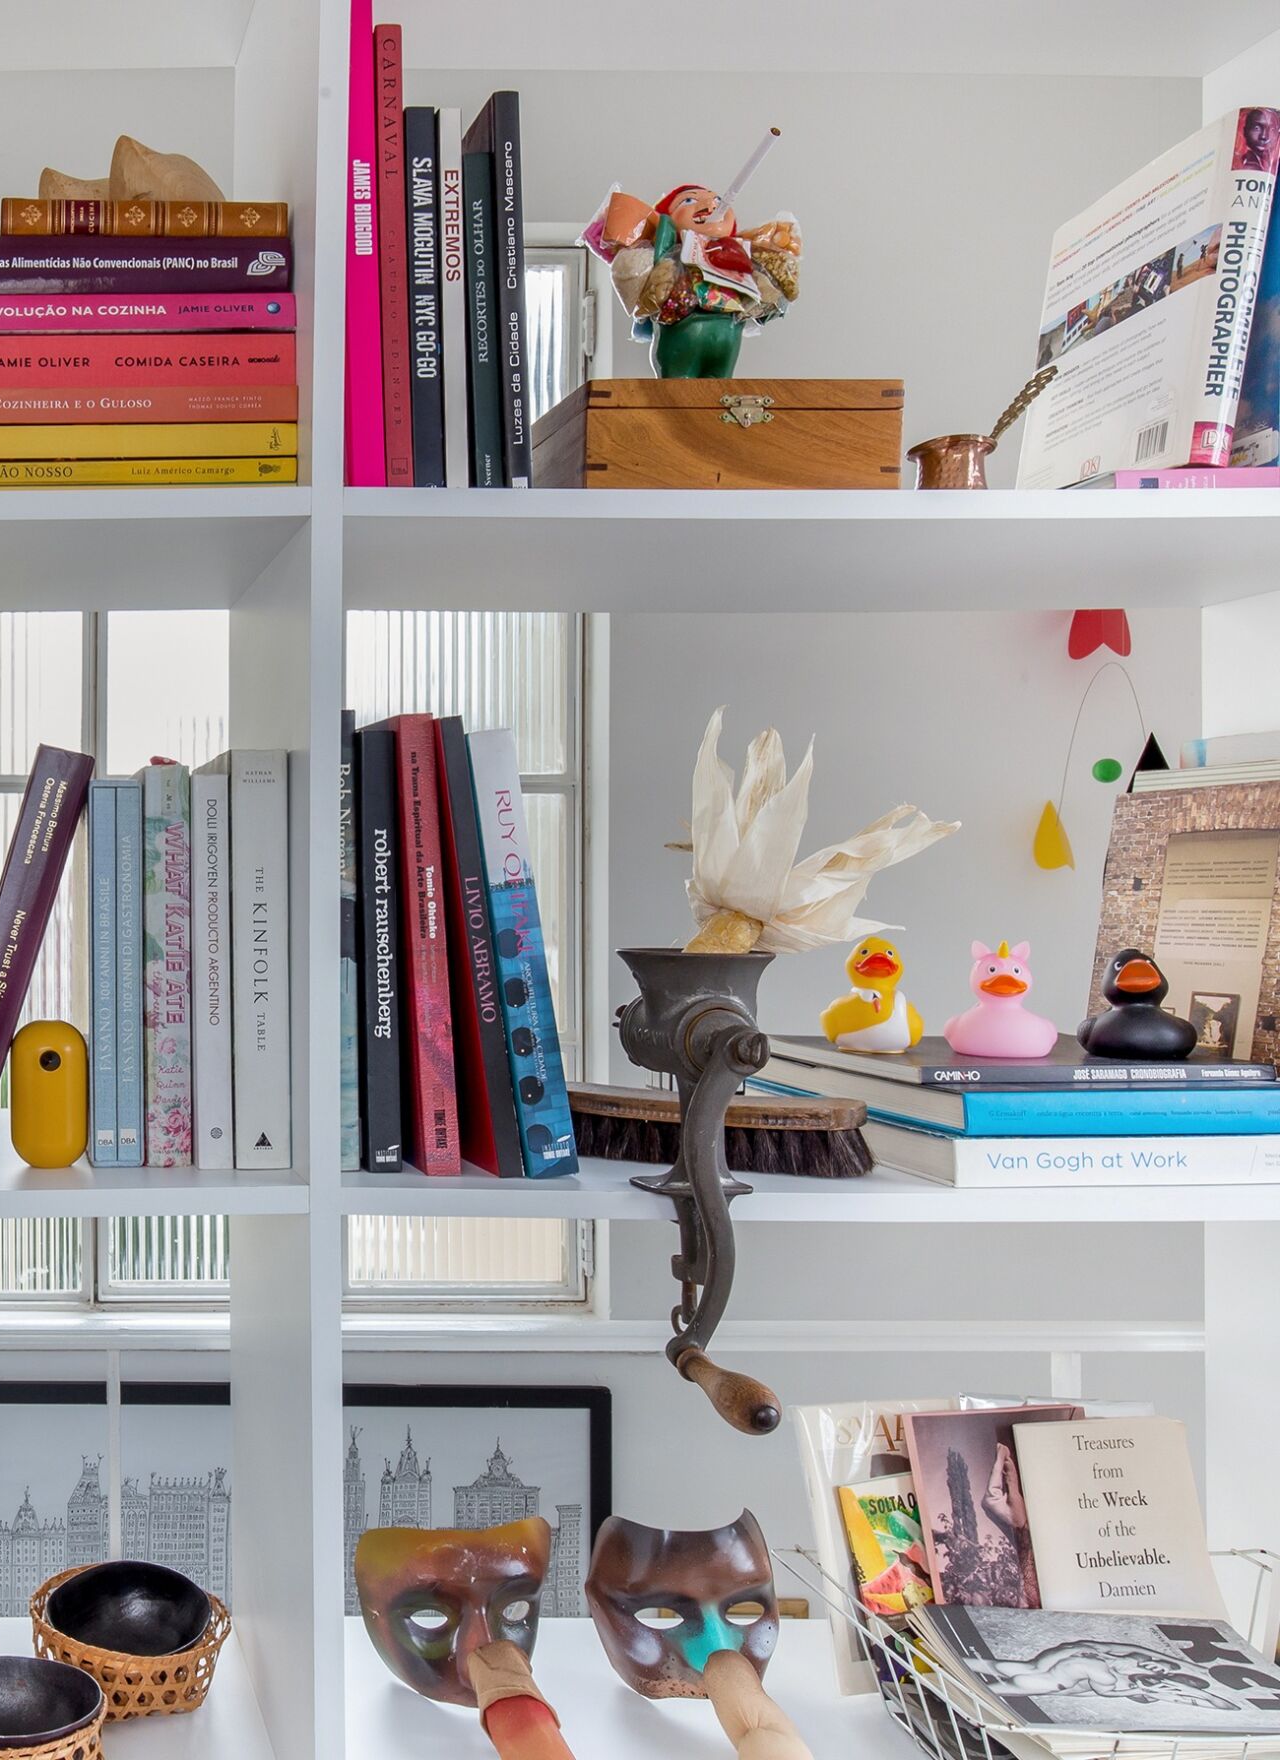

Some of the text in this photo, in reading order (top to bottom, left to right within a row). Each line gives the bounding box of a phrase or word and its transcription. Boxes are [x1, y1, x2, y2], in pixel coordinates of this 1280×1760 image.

[352, 159, 371, 200] JAMES
[382, 38, 399, 319] CARNAVAL CLAUDIO
[444, 170, 461, 282] EXTREMOS
[11, 257, 70, 268] Alimentícias
[72, 257, 92, 268] Não
[93, 257, 161, 269] Convencionais
[162, 257, 195, 271] (PANC)
[196, 260, 209, 268] no
[211, 257, 238, 268] Brasil
[412, 156, 437, 378] SLAVA MOGUTIN NYC GO-GO
[472, 199, 490, 363] RECORTES OLHAR
[72, 306, 93, 316] NA
[97, 305, 167, 316] COZINHA
[178, 305, 210, 315] JAMIE
[214, 304, 254, 314] OLIVER
[504, 141, 524, 445] Luzes da Cidade Cristiano Mascaro
[1204, 221, 1248, 397] PHOTOGRAPHER
[38, 357, 90, 368] OLIVER
[114, 356, 173, 367] COMIDA
[179, 356, 240, 366] CASEIRA
[24, 466, 73, 478] NOSSO
[131, 467, 150, 476] Luiz
[154, 465, 192, 475] Américo
[195, 466, 235, 476] Camargo
[495, 789, 519, 846] RUY
[24, 811, 46, 864] Francescana
[411, 752, 426, 939] na Trama da Arte Brasileira
[99, 877, 110, 929] BRASILE
[121, 835, 133, 938] GASTRONOMIA
[10, 910, 27, 941] Never
[165, 821, 186, 1024] WHAT KATIE ATE
[207, 799, 220, 1026] DOLLI IRIGOYEN PRODUCTO ARGENTINO
[374, 829, 395, 1039] robert rauschenberg
[252, 867, 269, 1052] THE KINFOLK TABLE
[472, 935, 497, 1023] ABRAMO
[158, 1065, 184, 1074] Katie
[1091, 1068, 1224, 1080] SARAMAGO Fernando
[98, 1138, 113, 1146] DBA
[120, 1137, 136, 1145] DBA
[987, 1151, 1188, 1172] Van Gogh at Work
[1072, 1433, 1135, 1451] Treasures
[1092, 1462, 1124, 1480] from
[869, 1495, 906, 1515] SOLTA
[1077, 1490, 1148, 1509] the Wreck
[1098, 1520, 1137, 1538] of the
[1076, 1548, 1171, 1570] Unbelievable.
[1099, 1580, 1156, 1598] Damien
